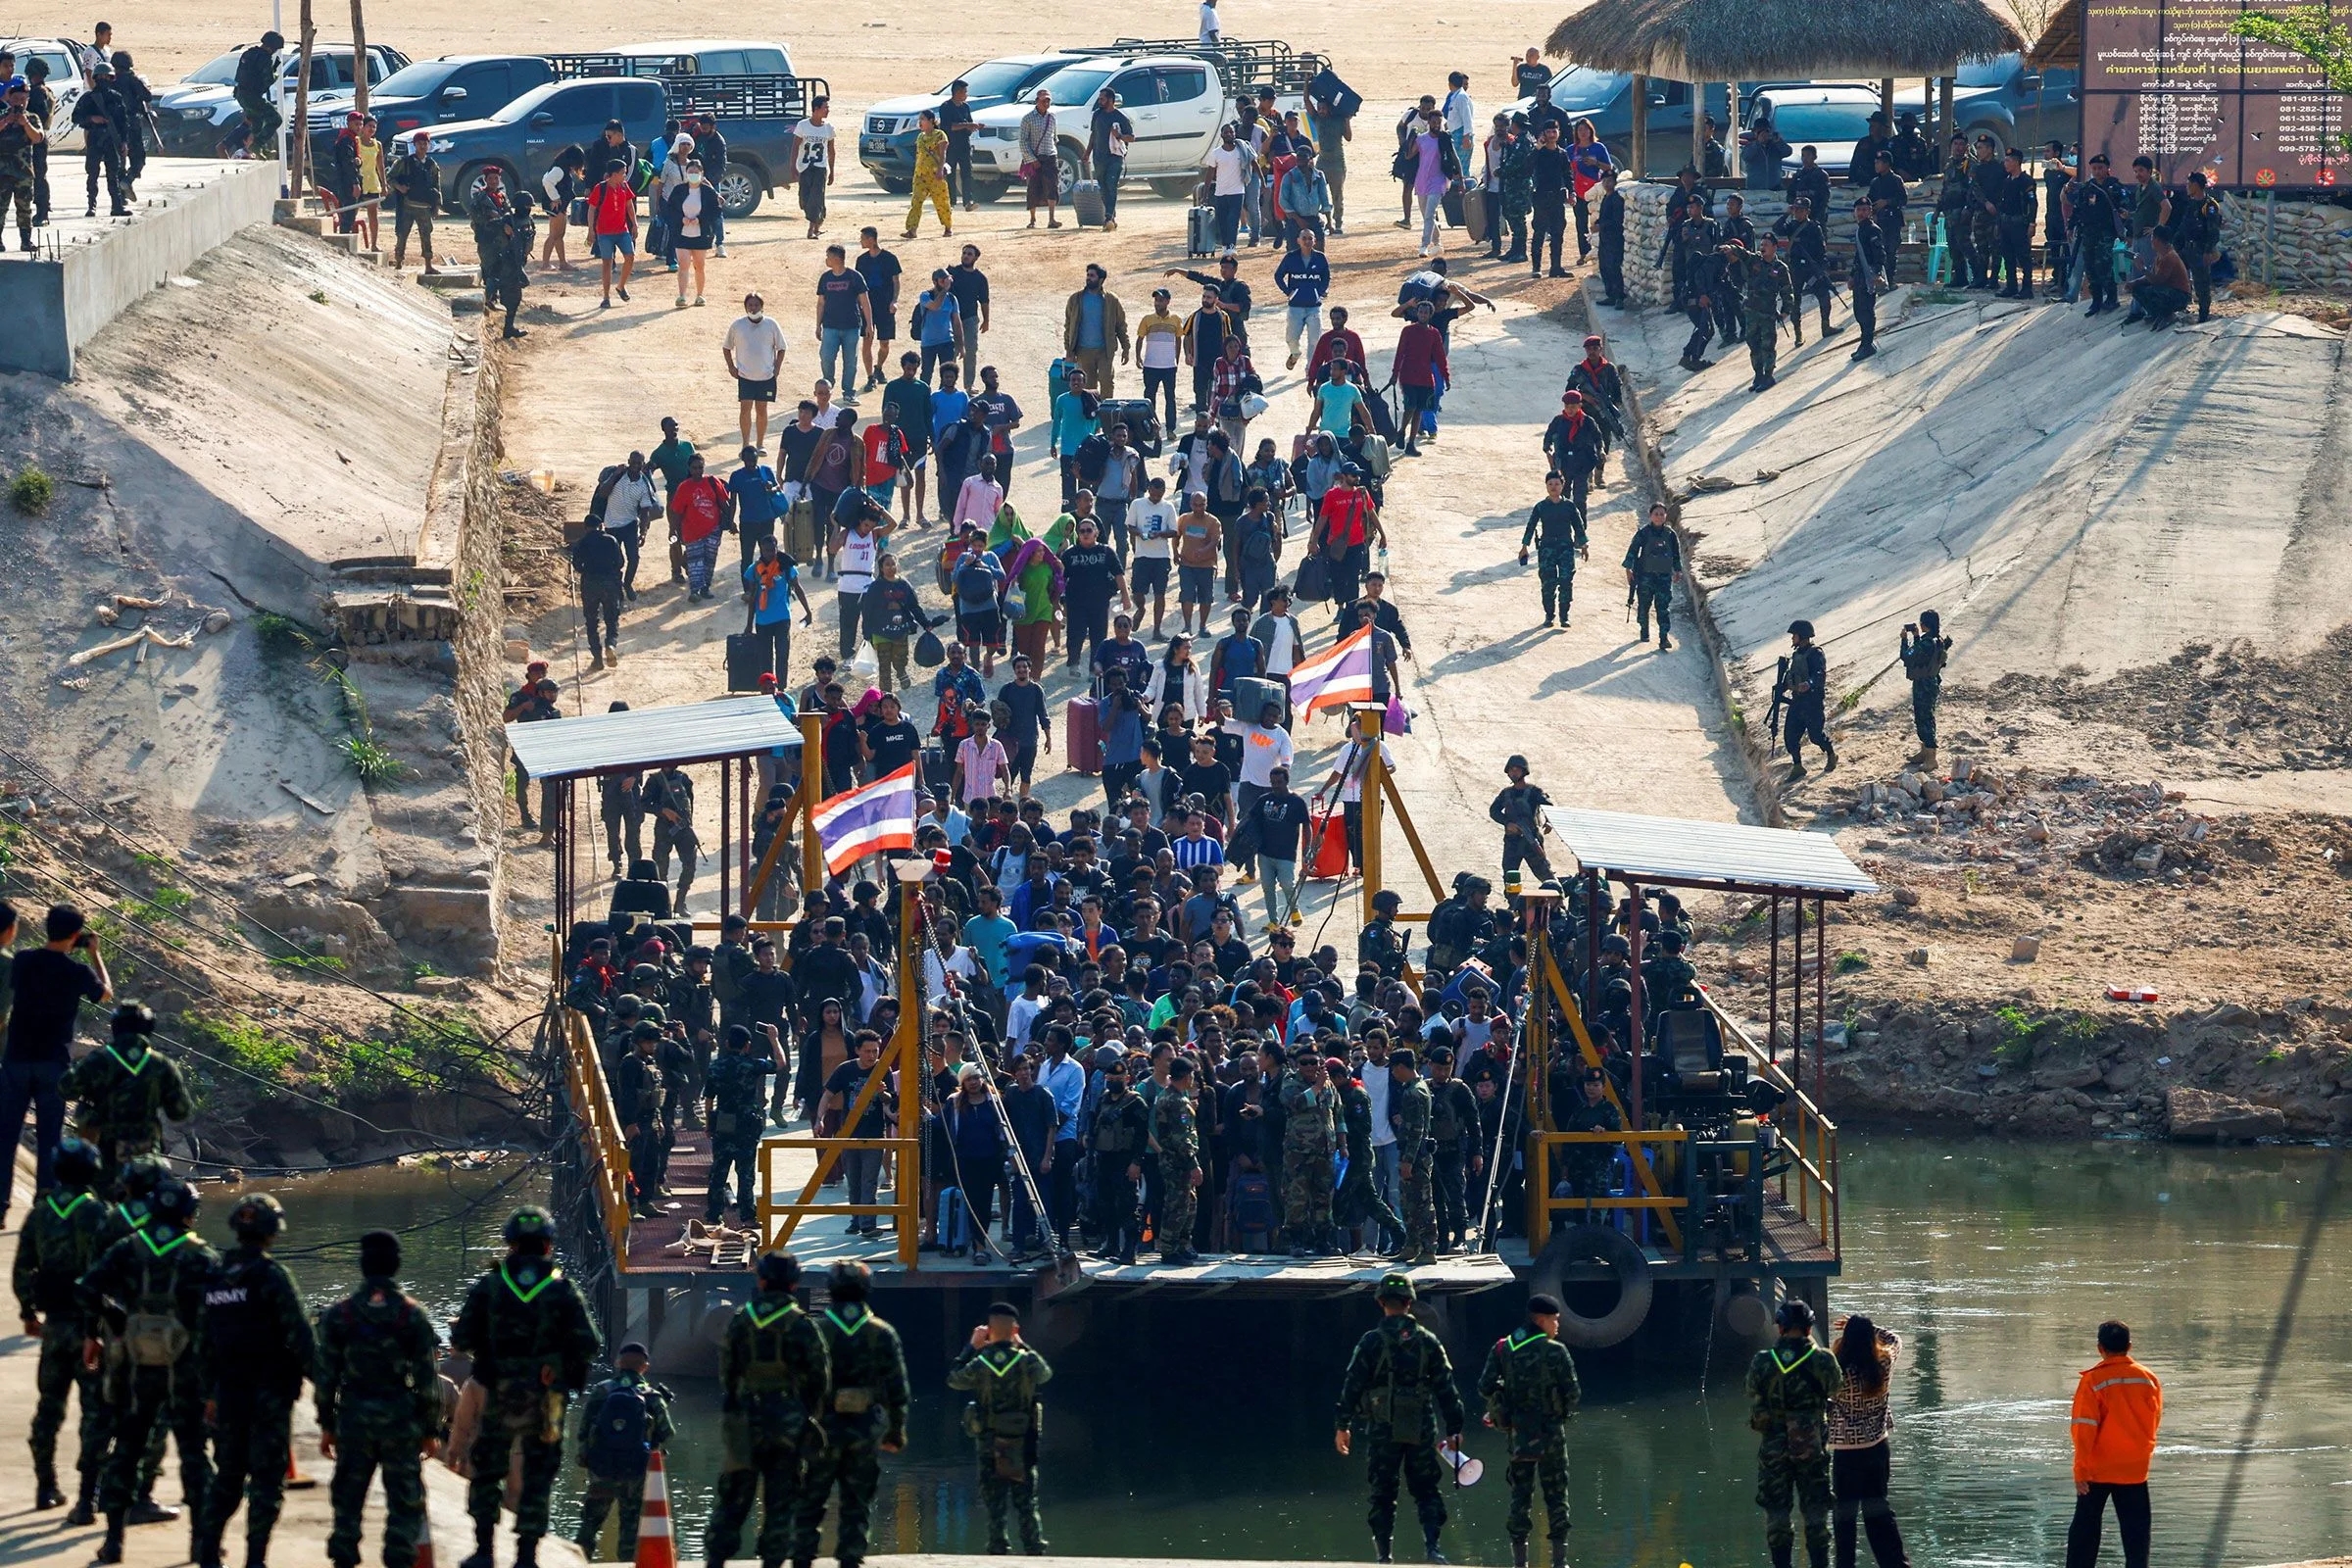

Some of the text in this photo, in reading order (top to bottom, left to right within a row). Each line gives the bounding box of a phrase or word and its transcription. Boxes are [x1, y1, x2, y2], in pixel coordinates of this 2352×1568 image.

[2210, 65, 2215, 74] 1
[803, 142, 824, 164] 13
[206, 1288, 247, 1305] ARMY
